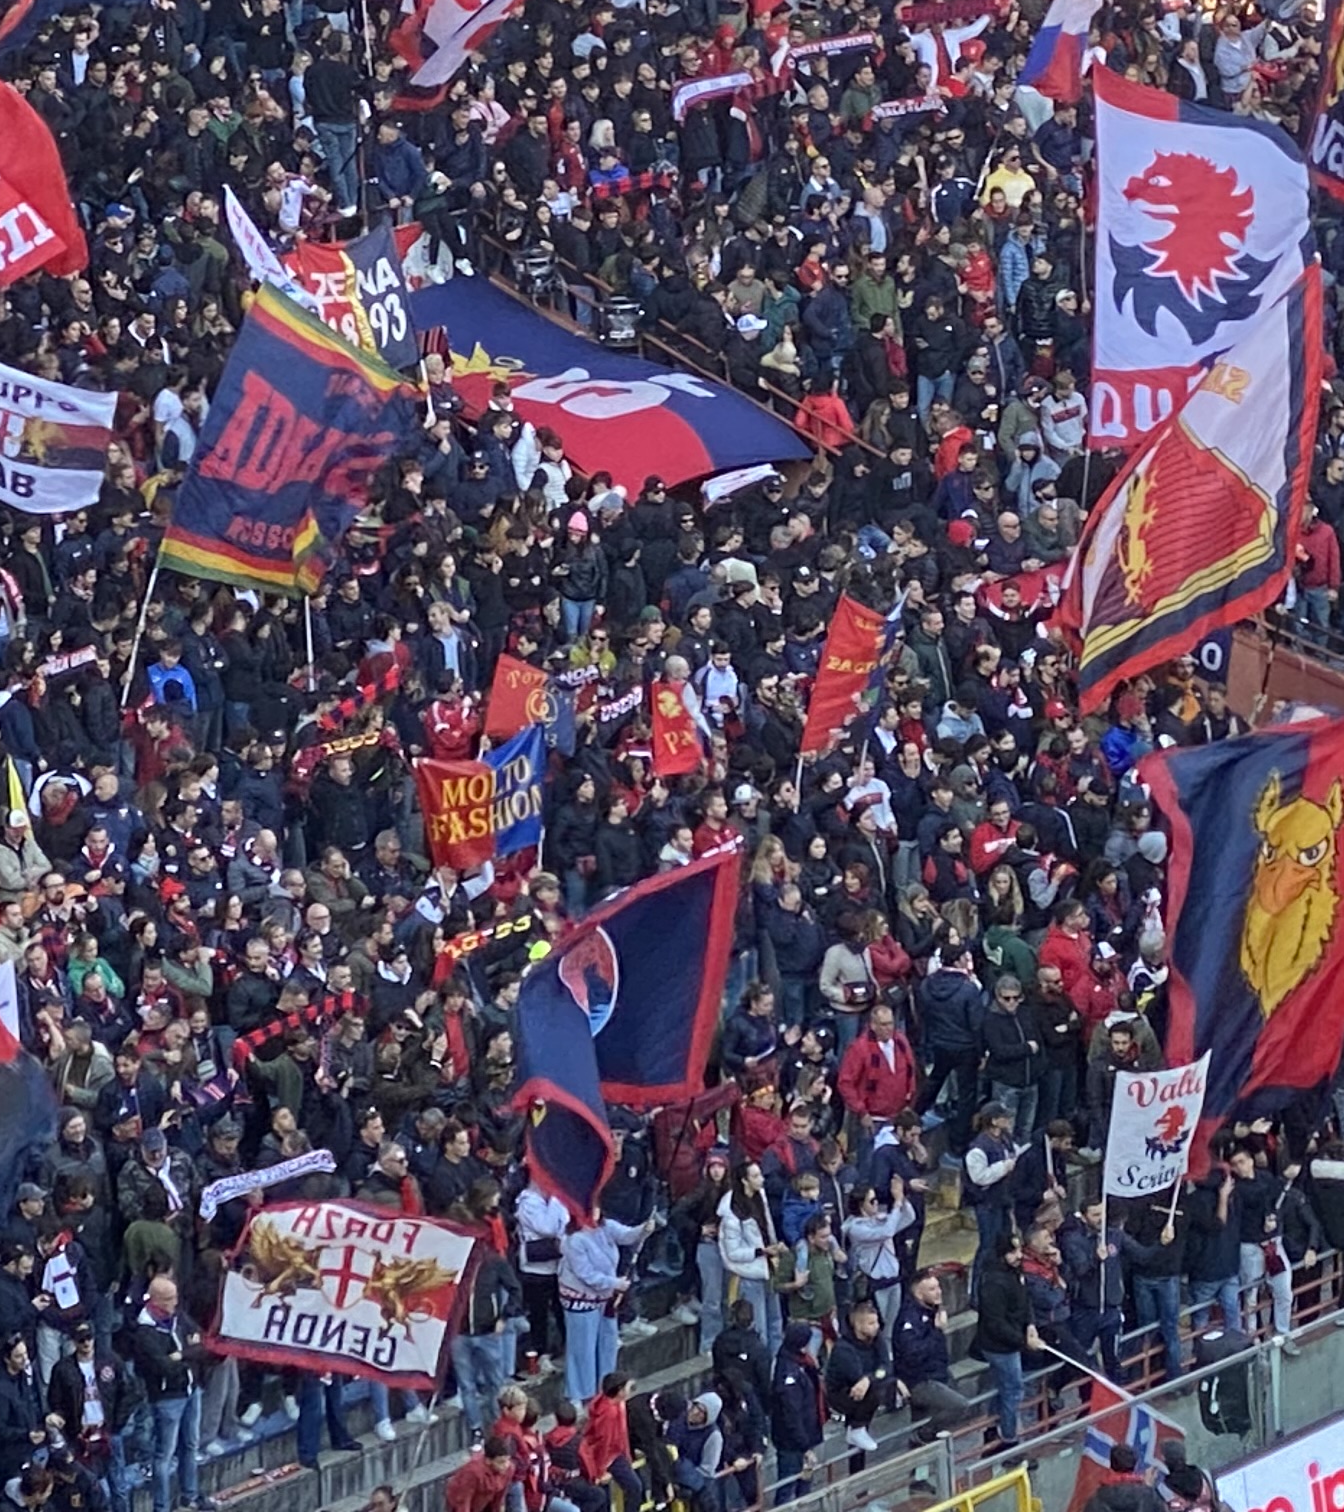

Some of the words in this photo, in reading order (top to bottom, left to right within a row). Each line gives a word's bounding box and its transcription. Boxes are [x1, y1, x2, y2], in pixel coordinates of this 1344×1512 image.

[311, 257, 401, 306] ZENA
[441, 756, 530, 808] MOLTO
[430, 786, 543, 845] FASHION
